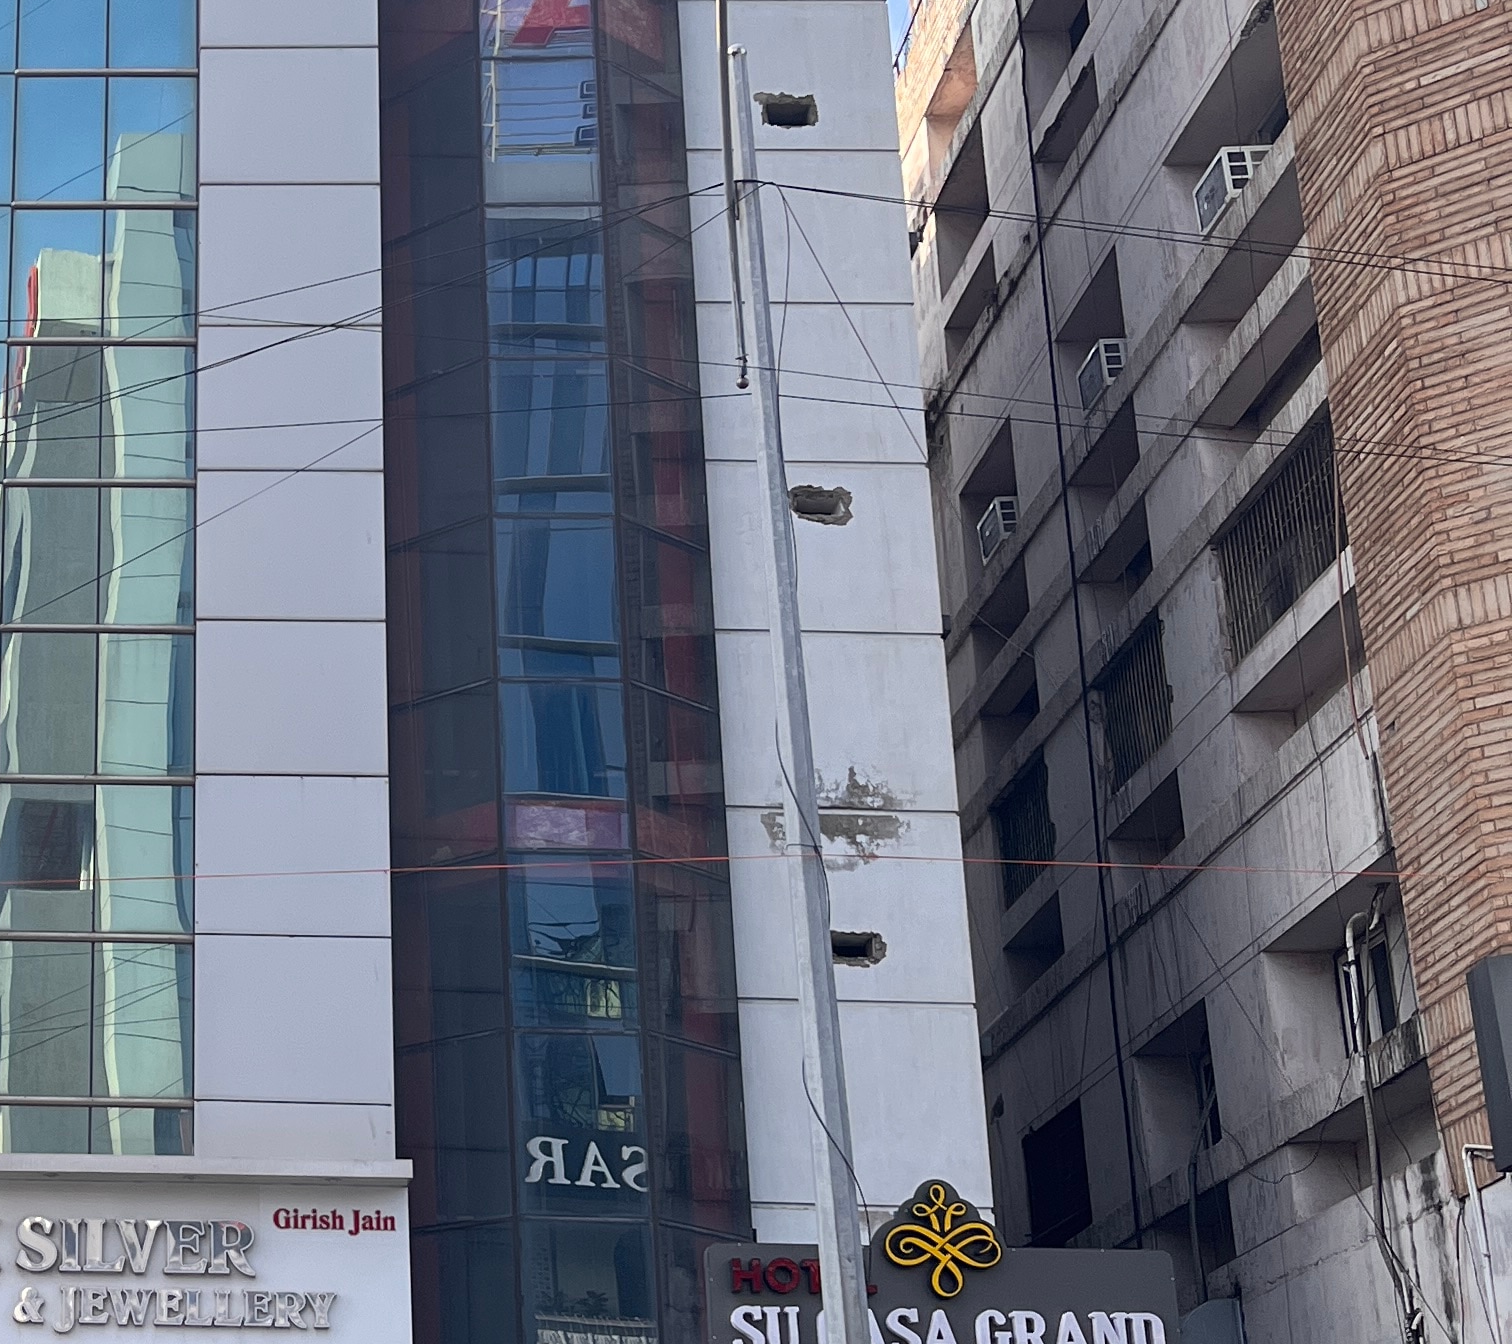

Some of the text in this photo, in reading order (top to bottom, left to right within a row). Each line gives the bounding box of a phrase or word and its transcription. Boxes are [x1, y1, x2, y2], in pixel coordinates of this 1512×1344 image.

[273, 1209, 396, 1236] Girish Jain
[15, 1216, 256, 1277] SILVER
[731, 1257, 878, 1295] HOT
[13, 1286, 337, 1333] & JEWELLERY
